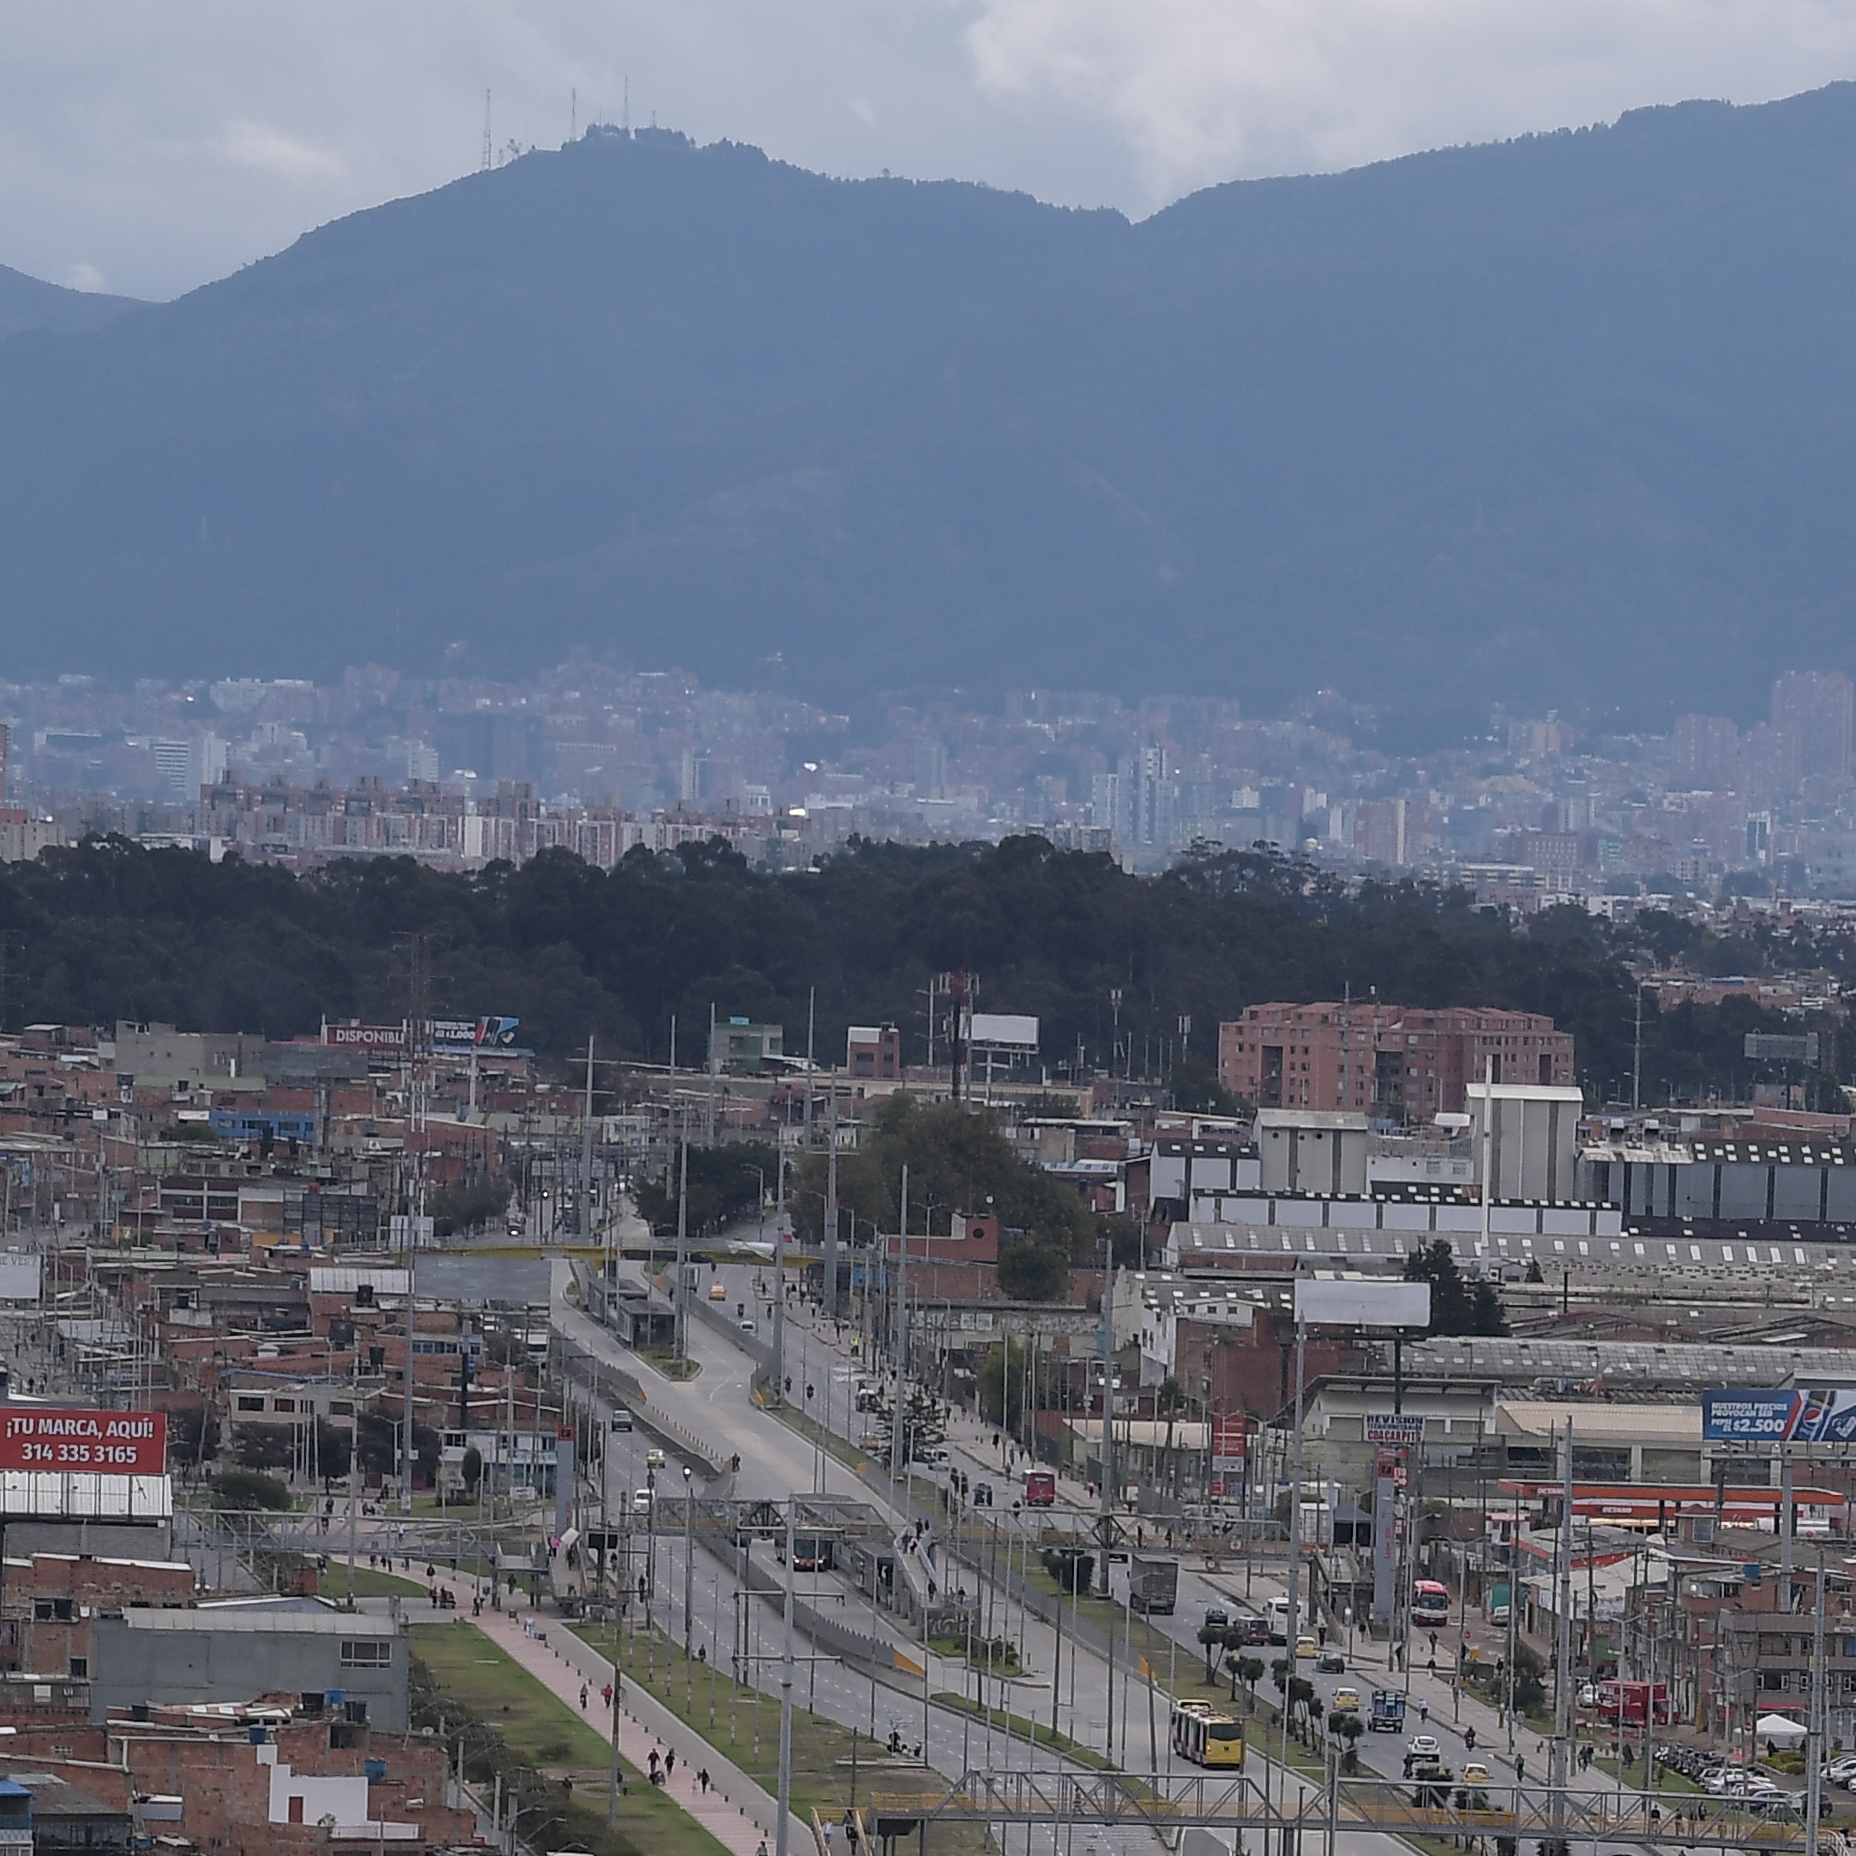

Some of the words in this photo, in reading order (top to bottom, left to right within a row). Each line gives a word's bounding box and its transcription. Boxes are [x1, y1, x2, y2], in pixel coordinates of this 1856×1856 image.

[6, 1417, 35, 1438] ¡TU
[38, 1418, 103, 1440] MARCA,
[105, 1416, 154, 1440] AQUÍ!
[21, 1443, 54, 1461] 314
[57, 1444, 91, 1463] 335
[93, 1445, 138, 1464] 3165
